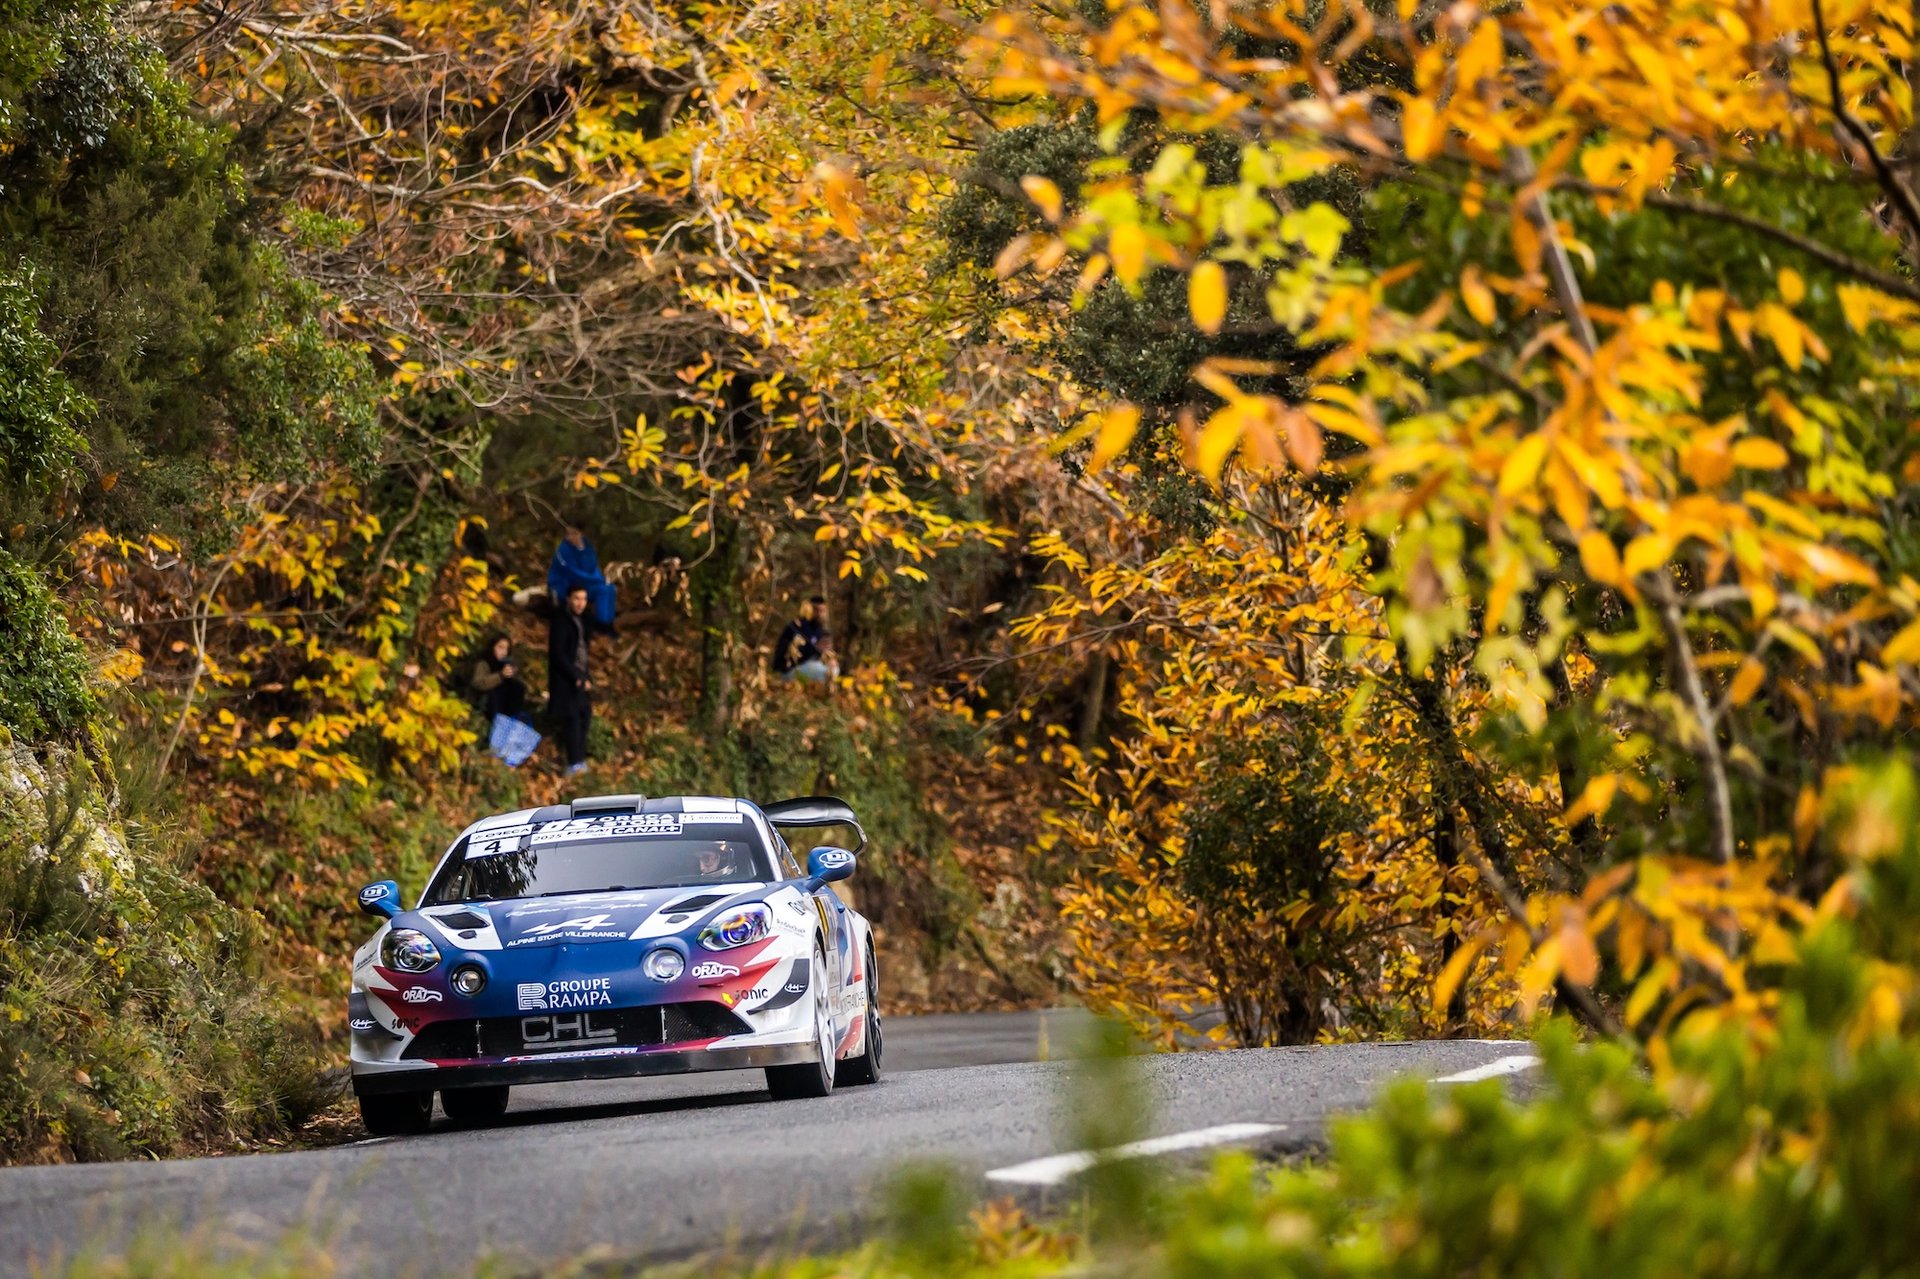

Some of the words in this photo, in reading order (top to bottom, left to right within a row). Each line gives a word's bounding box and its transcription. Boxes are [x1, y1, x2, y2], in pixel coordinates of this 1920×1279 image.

[600, 813, 675, 821] ORECA
[613, 825, 679, 834] CANAL+
[484, 840, 502, 853] 4
[506, 938, 536, 947] ALPINE
[537, 933, 563, 942] STORE
[549, 978, 611, 993] GROUPE
[549, 991, 612, 1009] RAMPA
[521, 1013, 617, 1042] CHL
